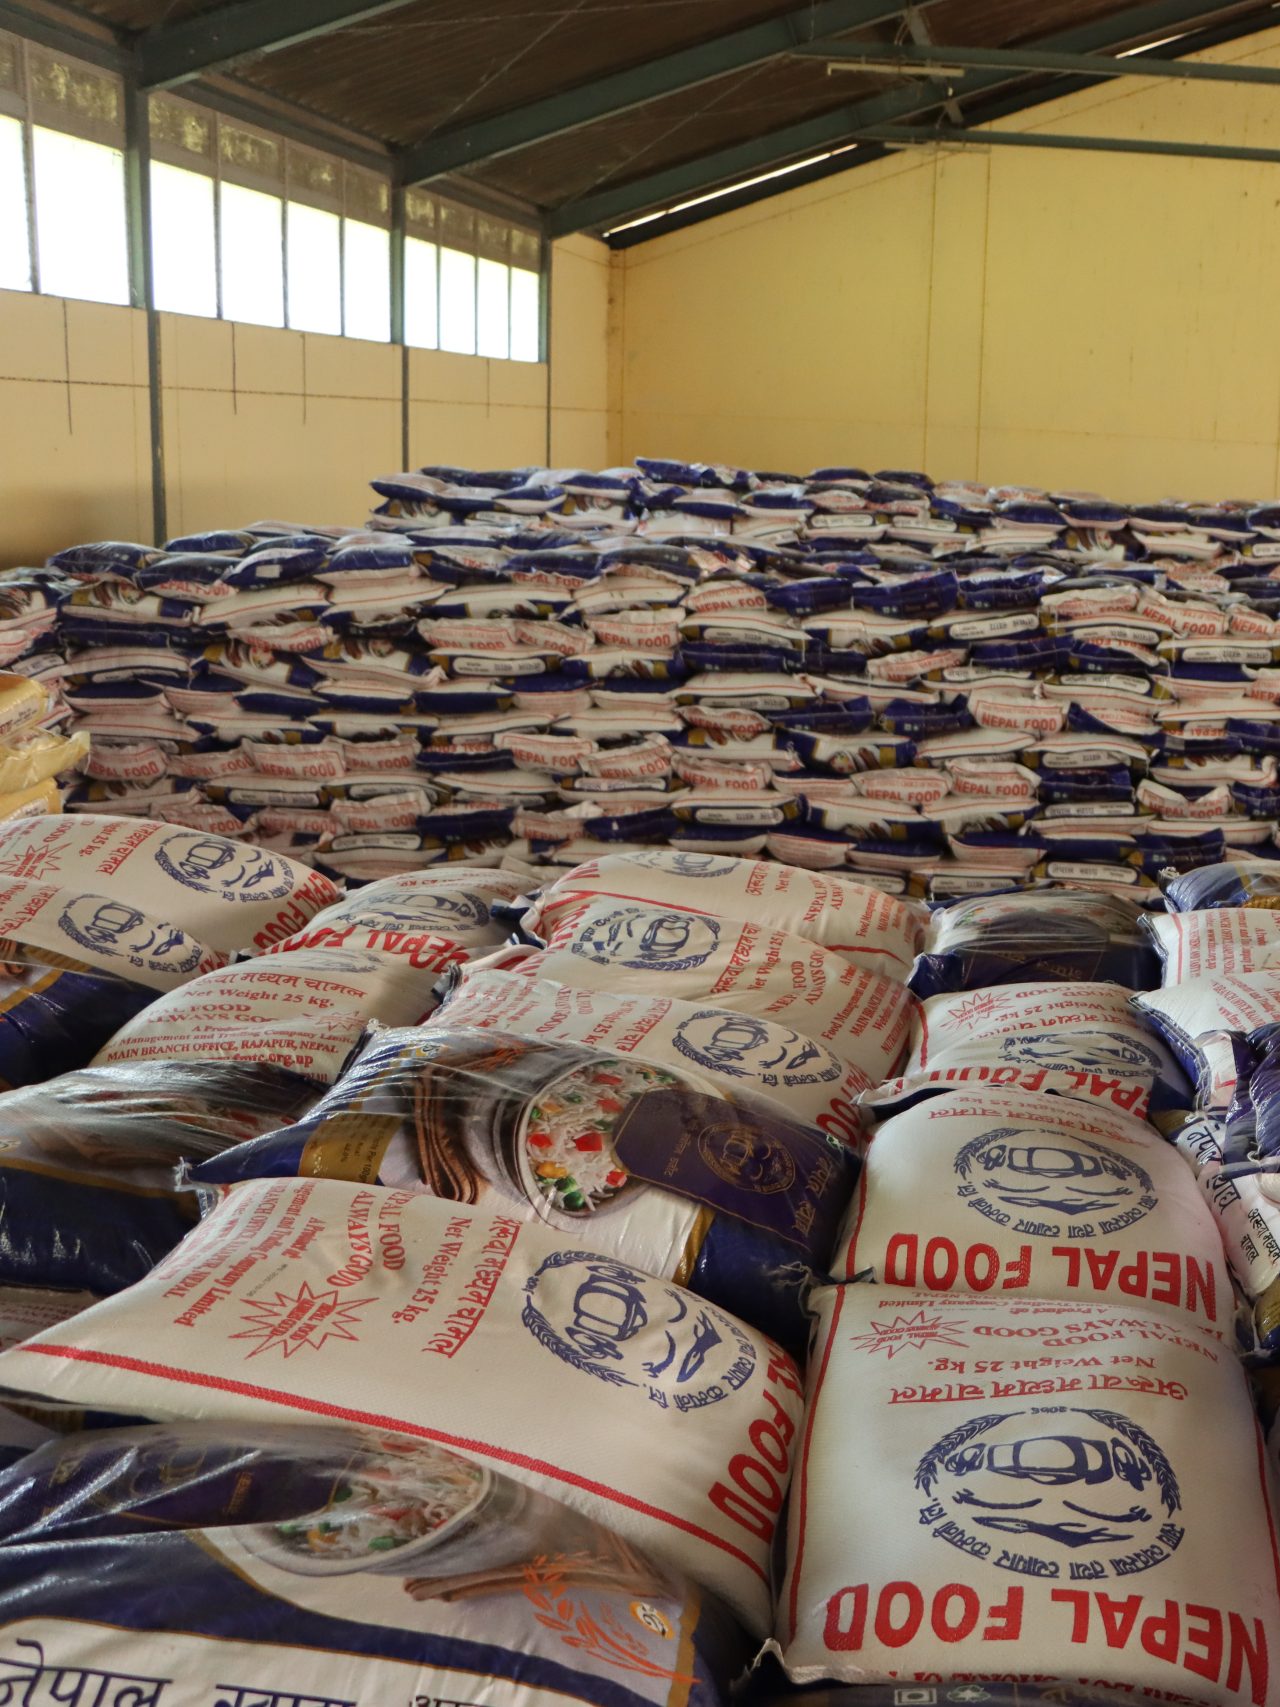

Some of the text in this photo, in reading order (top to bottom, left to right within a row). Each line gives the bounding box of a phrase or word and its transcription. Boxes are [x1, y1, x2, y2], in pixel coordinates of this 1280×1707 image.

[1143, 607, 1217, 636] NEPAL FOOD
[1231, 619, 1270, 633] NEPAL
[596, 632, 671, 647] NEPAL FOOD
[982, 711, 1063, 733] NEPAL FOOD
[124, 761, 160, 777] FOOD
[377, 756, 409, 769] FOOD
[511, 750, 546, 766] NEPAL
[262, 764, 337, 777] NEPAL FOOD
[600, 766, 635, 780] NEPAL
[683, 772, 758, 790] NEPAL FOOD
[866, 789, 941, 802] NEPAL FOOD
[955, 781, 1029, 796] NEPAL FOOD
[803, 885, 828, 923] NEPAL
[241, 971, 368, 999] मध्यम चामल
[805, 971, 826, 1006] ALWAYS
[219, 988, 278, 1001] Weight
[282, 994, 303, 1003] 25
[308, 995, 335, 1008] kg.
[1049, 1001, 1105, 1014] Weight
[994, 1011, 1019, 1023] kg.
[1023, 1006, 1044, 1017] 25
[263, 1028, 315, 1038] Company
[821, 1020, 841, 1041] Food
[107, 1038, 338, 1062] MAIN BRANCH OFFICE, RAJAPUR, NEPAL
[927, 1107, 1002, 1121] चामल
[967, 1195, 1012, 1226] कम्पनी
[1100, 1205, 1148, 1236] व्यवस्था
[278, 1216, 295, 1230] and
[1011, 1217, 1061, 1239] व्यापार
[1067, 1222, 1097, 1239] तथा
[250, 1226, 293, 1251] Trading
[294, 1222, 326, 1252] Product
[326, 1190, 378, 1287] ALWAYS GOOD
[378, 1224, 406, 1271] FOOD
[214, 1251, 269, 1288] Company
[391, 1216, 472, 1324] Net Weight 25 kg.
[883, 1232, 1218, 1322] NEPAL FOOD
[162, 1270, 212, 1299] NEPAL
[457, 1257, 508, 1308] मध्यम
[174, 1286, 232, 1328] Limited
[878, 1299, 936, 1309] Limited
[1031, 1307, 1093, 1315] Product
[421, 1307, 485, 1359] चामल
[973, 1325, 1060, 1338] GOOD
[1042, 1329, 1219, 1364] NEPAL FOOD
[927, 1354, 1157, 1376] Net Weight 25 kg.
[673, 1385, 729, 1413] कम्पनी
[887, 1374, 1189, 1405] अरूवा मध्यम चामल
[707, 1389, 796, 1544] FOOD
[917, 1498, 1170, 1580] व्यवस्था तथा व्यापार कम्पनी लि.
[822, 1580, 1025, 1652] FOOD
[1050, 1588, 1270, 1707] NEPAL
[0, 1638, 173, 1707] नेपाल
